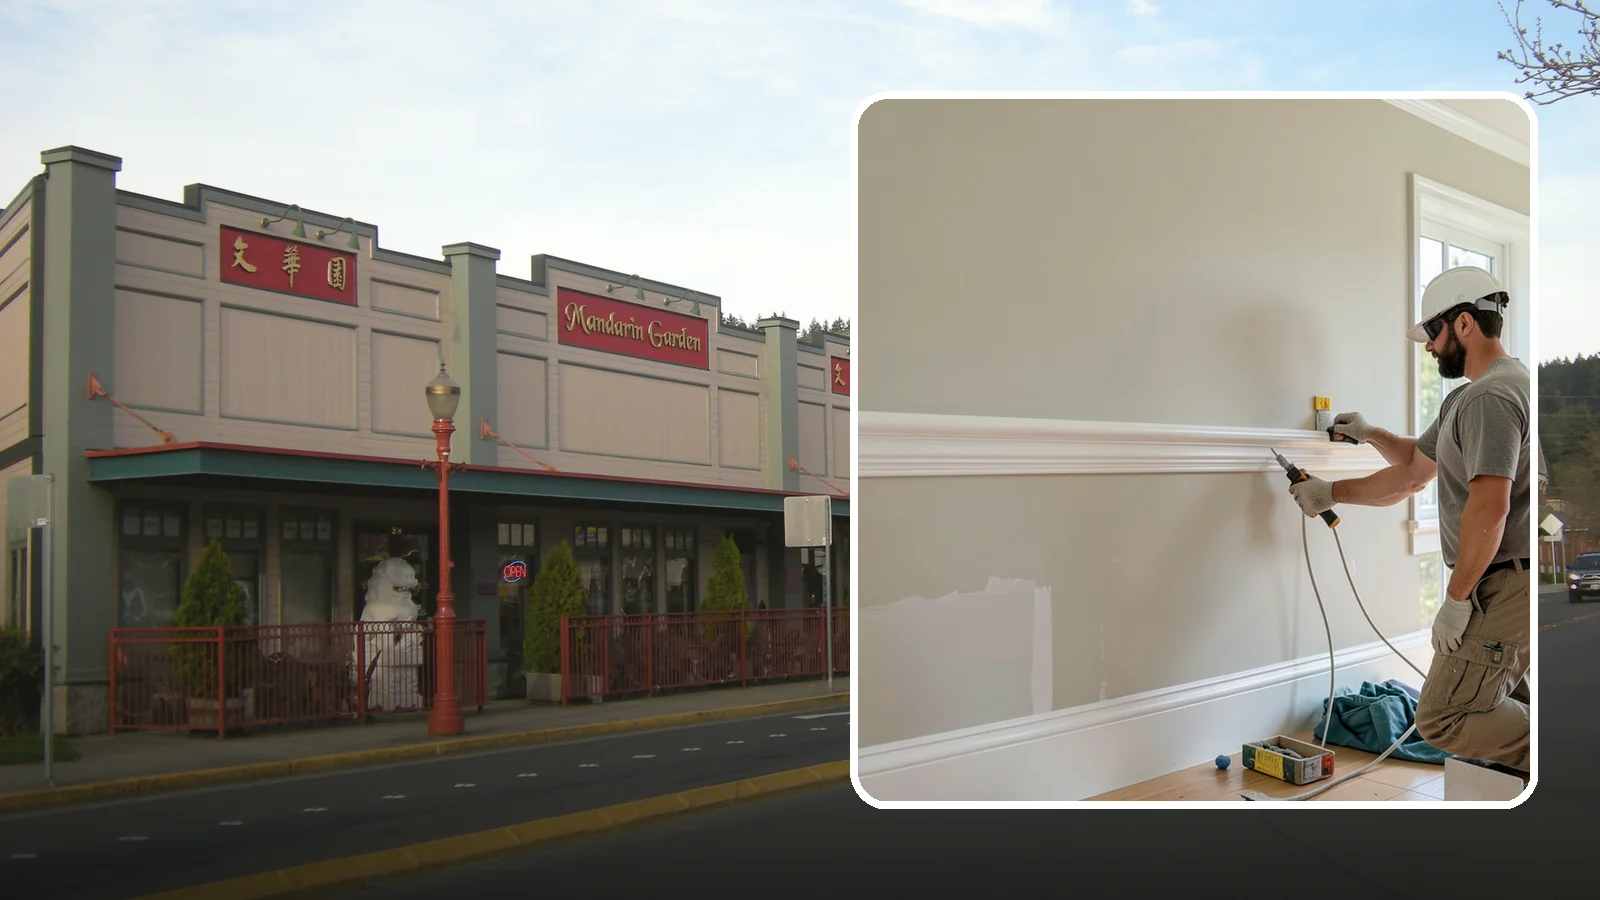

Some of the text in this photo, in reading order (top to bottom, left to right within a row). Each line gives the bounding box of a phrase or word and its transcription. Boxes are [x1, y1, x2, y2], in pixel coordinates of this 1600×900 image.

[230, 235, 346, 290] 文華園
[564, 302, 701, 352] Mandarin Garden
[503, 565, 527, 578] OPEN
